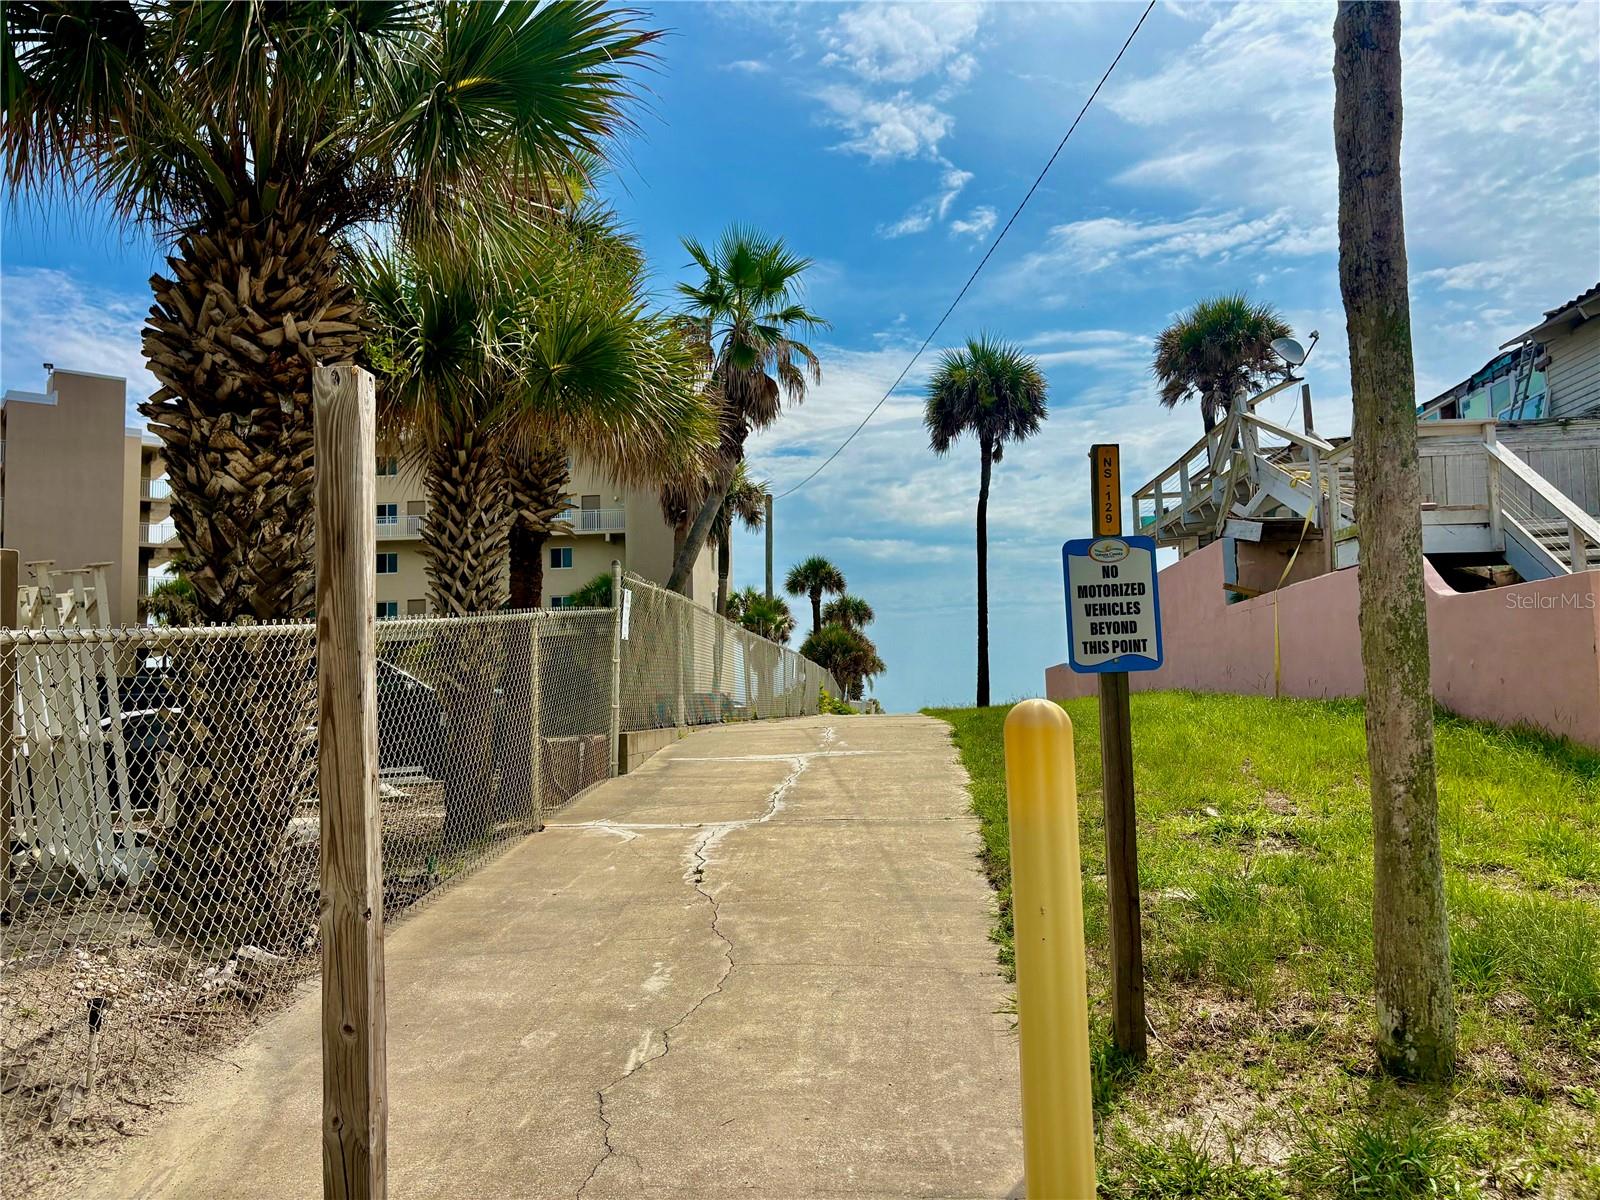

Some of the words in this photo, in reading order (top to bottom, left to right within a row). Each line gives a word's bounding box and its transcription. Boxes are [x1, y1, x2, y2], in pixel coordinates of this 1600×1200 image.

[1102, 565, 1119, 579] NO
[1077, 583, 1145, 598] MOTORIZED
[1084, 602, 1141, 617] VEHICLES
[1090, 620, 1138, 636] BEYOND
[1082, 640, 1110, 655] THIS
[1112, 638, 1148, 654] POINT
